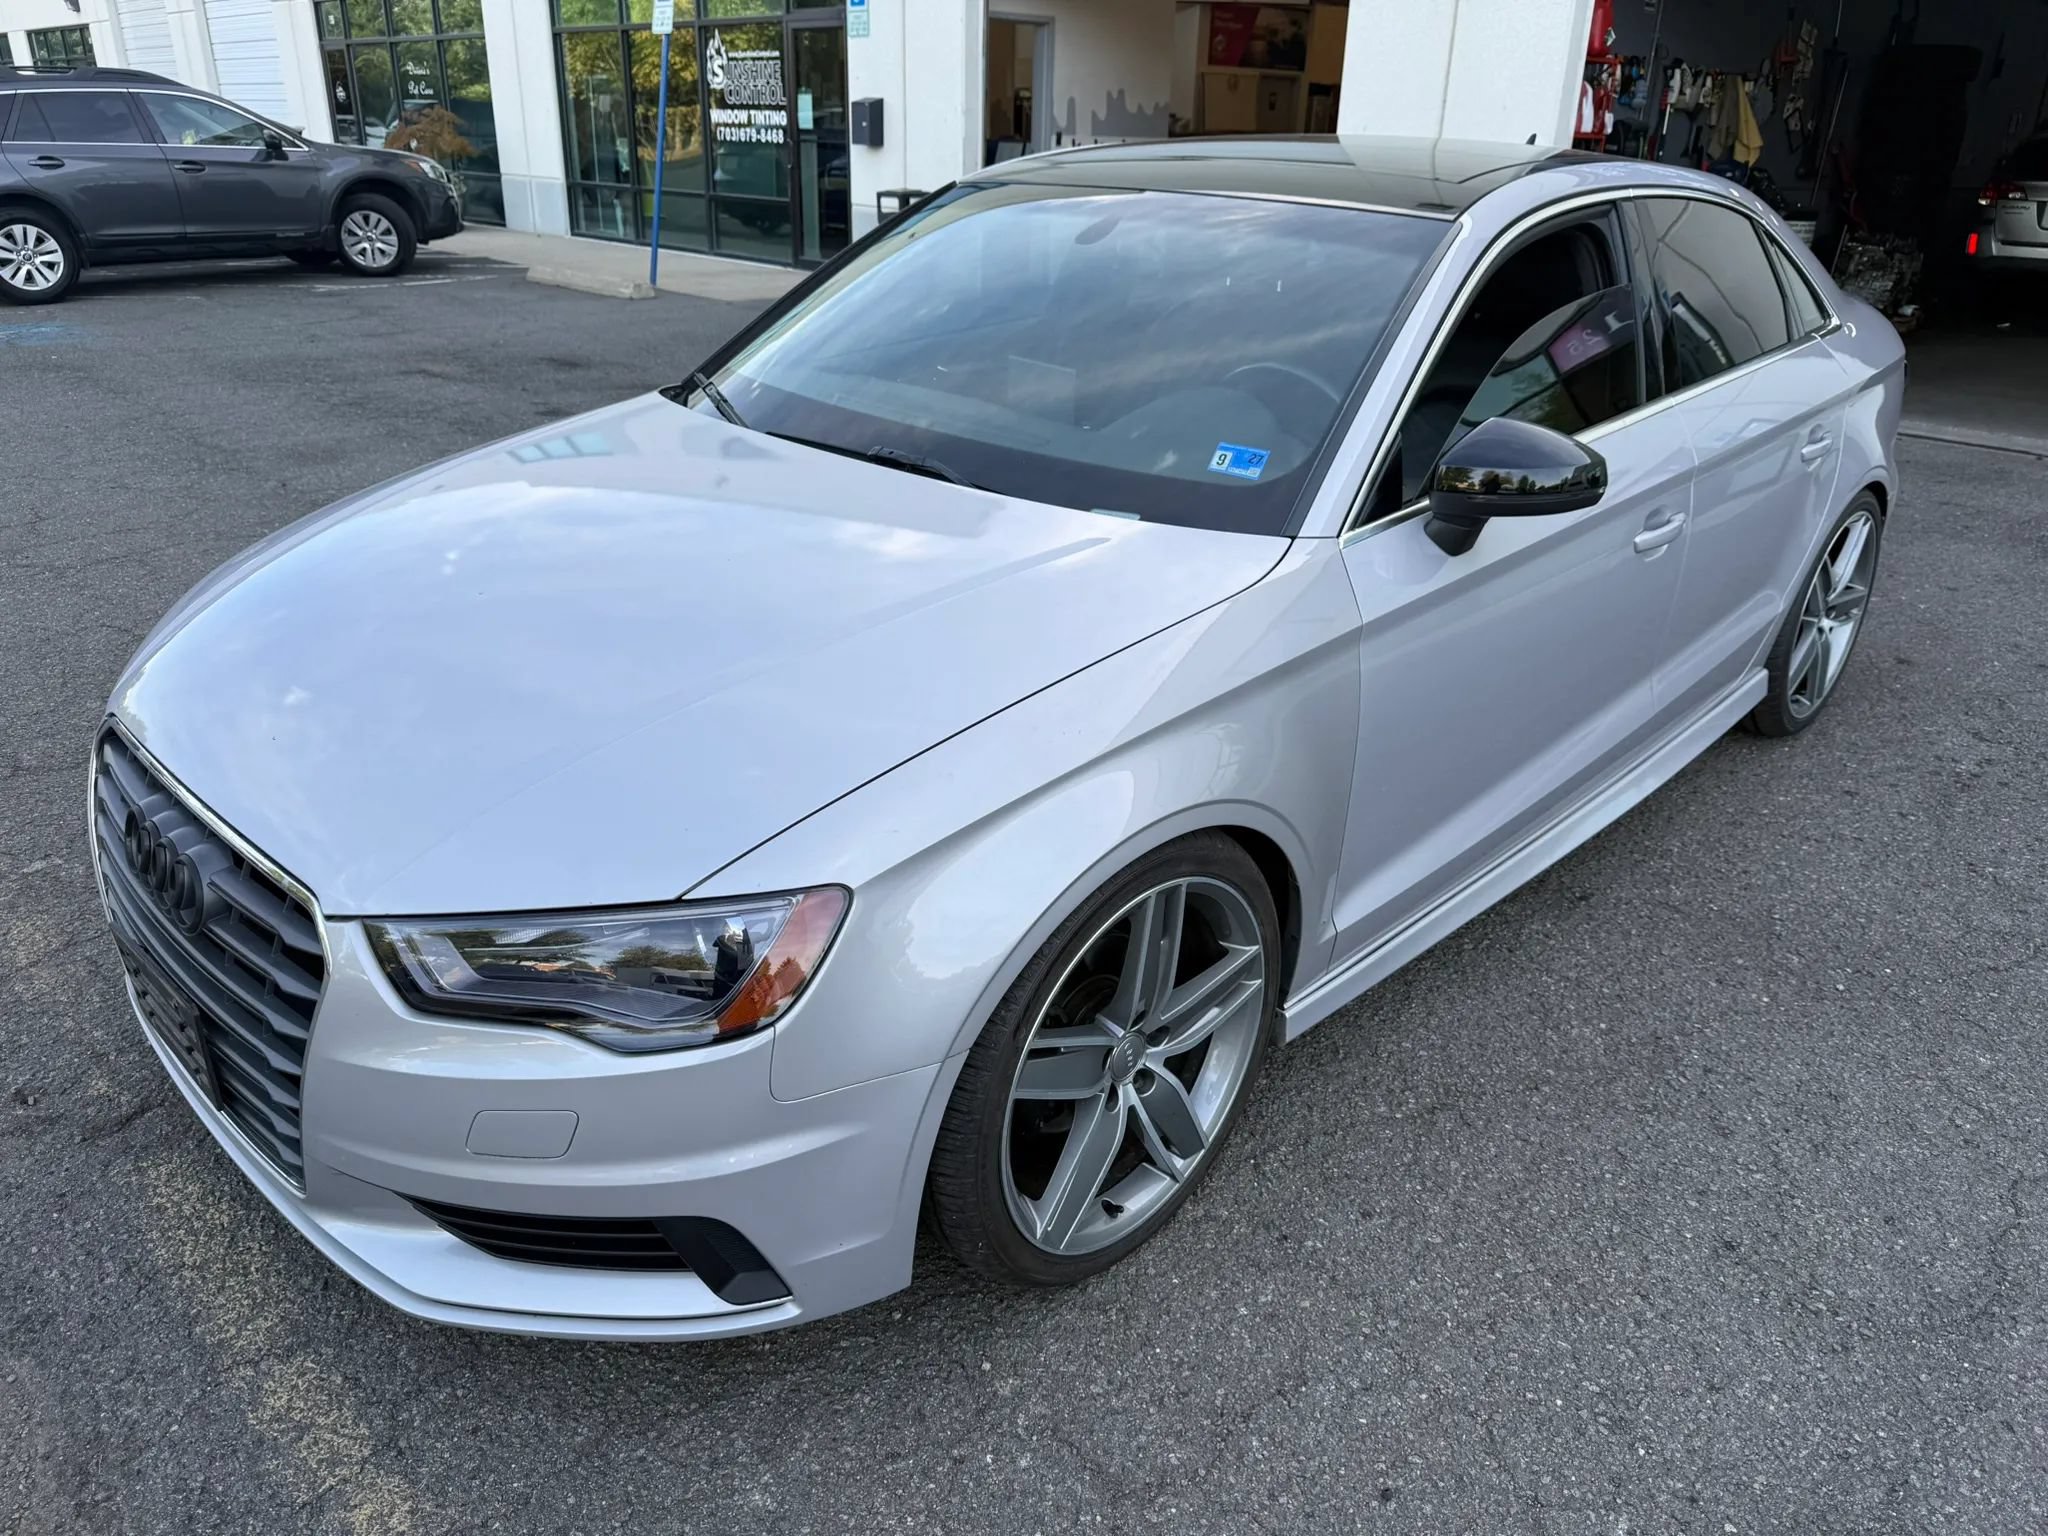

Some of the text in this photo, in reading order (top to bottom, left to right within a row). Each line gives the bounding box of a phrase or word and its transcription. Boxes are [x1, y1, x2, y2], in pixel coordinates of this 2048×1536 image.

[712, 59, 781, 83] SUNSHINE
[725, 83, 787, 105] CONTROL
[709, 109, 787, 126] WINDOW TINTING
[1216, 453, 1265, 466] 9 27
